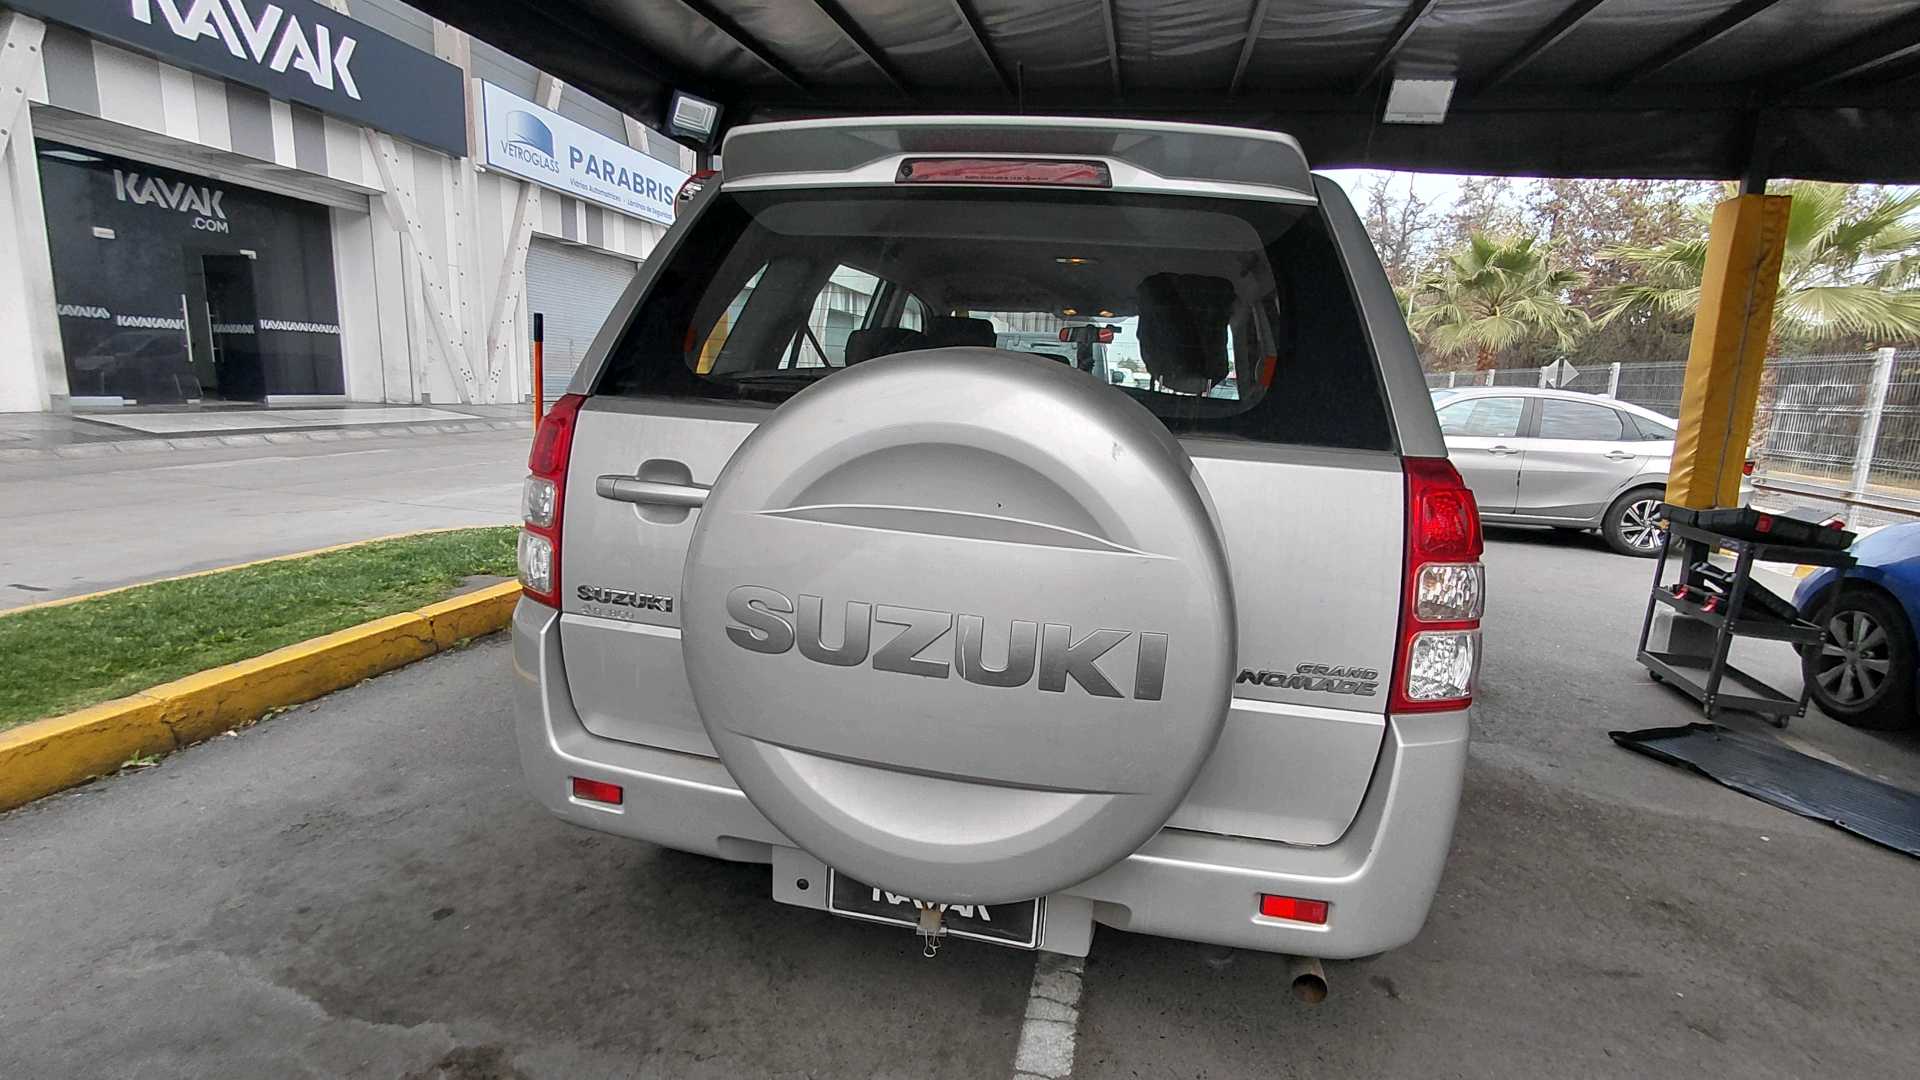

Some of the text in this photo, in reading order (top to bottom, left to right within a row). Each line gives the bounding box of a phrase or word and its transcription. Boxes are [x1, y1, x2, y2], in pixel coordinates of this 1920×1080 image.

[500, 139, 560, 174] VETROGLASS
[568, 146, 674, 206] PARABRIS
[113, 168, 226, 219] KAVAK
[192, 217, 229, 234] .COM
[577, 584, 673, 613] SUZUKI
[725, 584, 1169, 701] SUZUKI
[1235, 668, 1379, 697] NOMADE
[1296, 662, 1378, 681] GRAND
